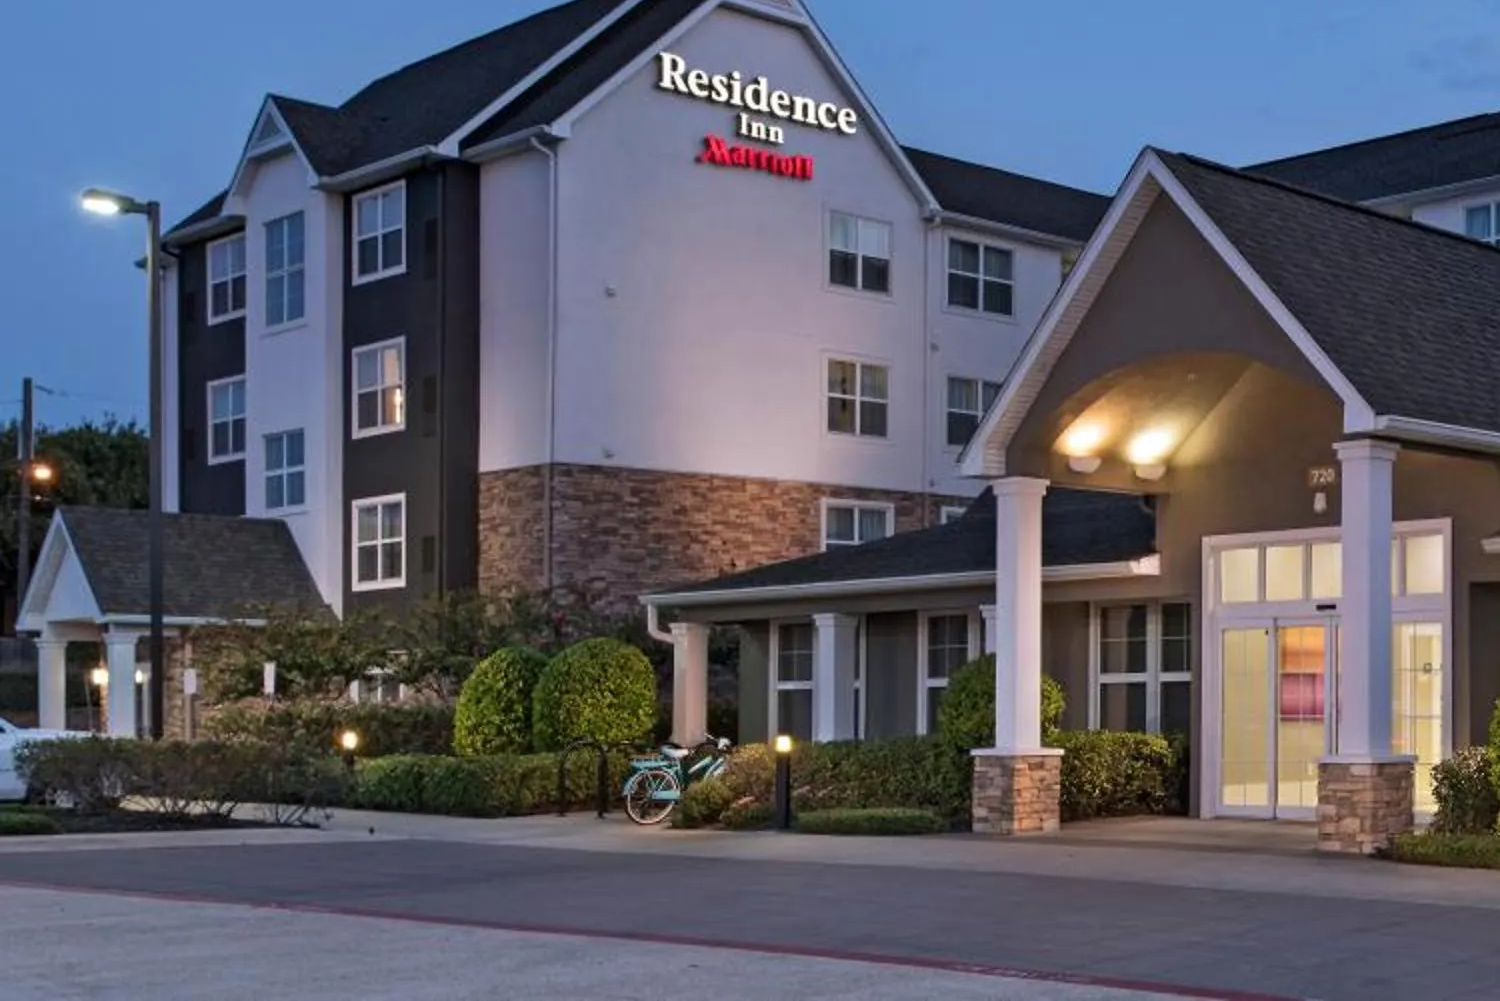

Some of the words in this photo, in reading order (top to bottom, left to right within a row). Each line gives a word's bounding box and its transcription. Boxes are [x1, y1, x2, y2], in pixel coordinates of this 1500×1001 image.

[659, 52, 857, 134] Residence
[740, 112, 784, 144] Inn
[698, 134, 814, 180] Marriott
